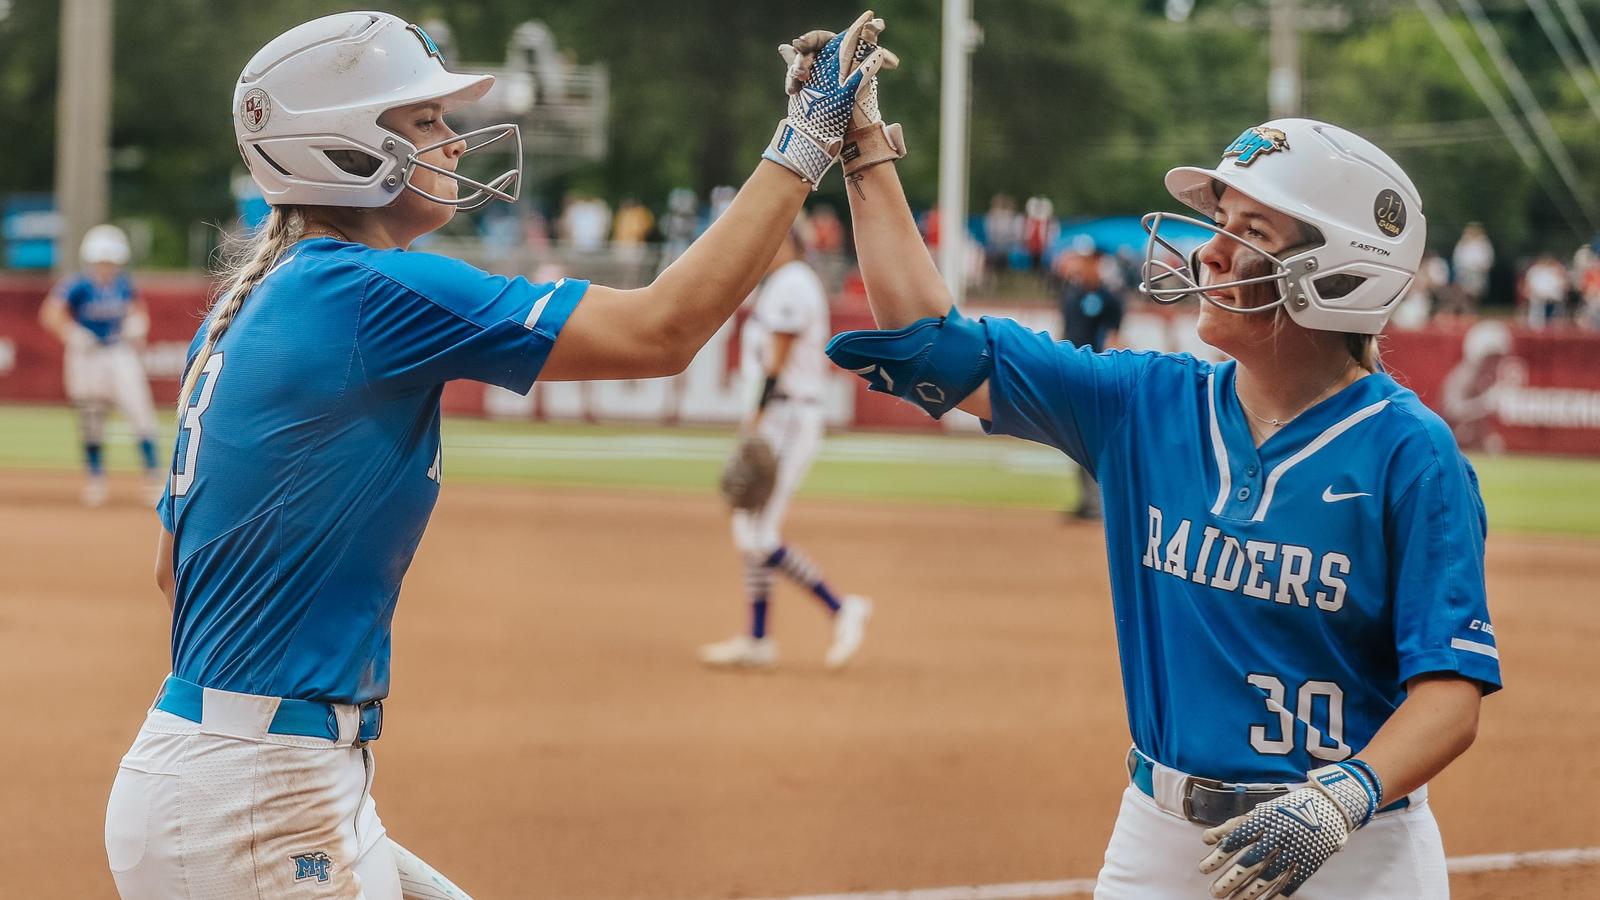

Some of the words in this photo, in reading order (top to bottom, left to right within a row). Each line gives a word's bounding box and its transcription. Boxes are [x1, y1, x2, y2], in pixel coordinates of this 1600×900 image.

[1350, 240, 1391, 257] EASTON
[1142, 504, 1352, 613] RAIDERS
[1247, 673, 1352, 763] 30
[295, 853, 330, 882] MT
